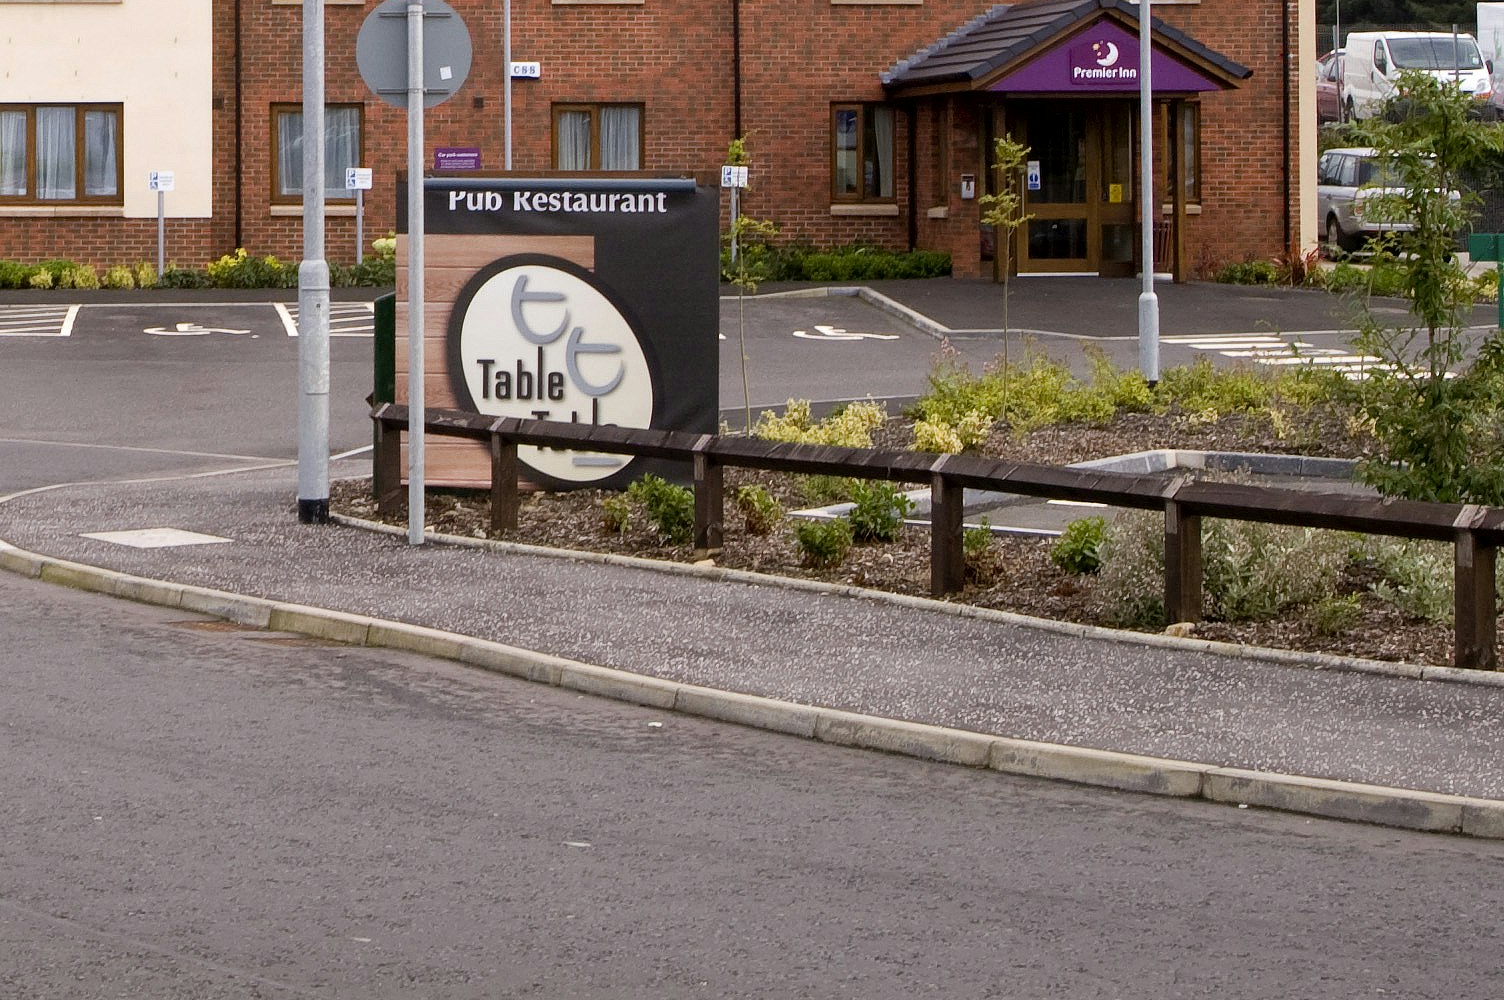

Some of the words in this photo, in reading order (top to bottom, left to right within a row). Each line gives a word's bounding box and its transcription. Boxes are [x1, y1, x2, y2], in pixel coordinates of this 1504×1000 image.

[1073, 66, 1118, 79] Premier
[1119, 66, 1137, 79] Inn
[448, 191, 503, 212] Pub
[513, 191, 668, 213] Restaurant
[476, 345, 565, 401] Table
